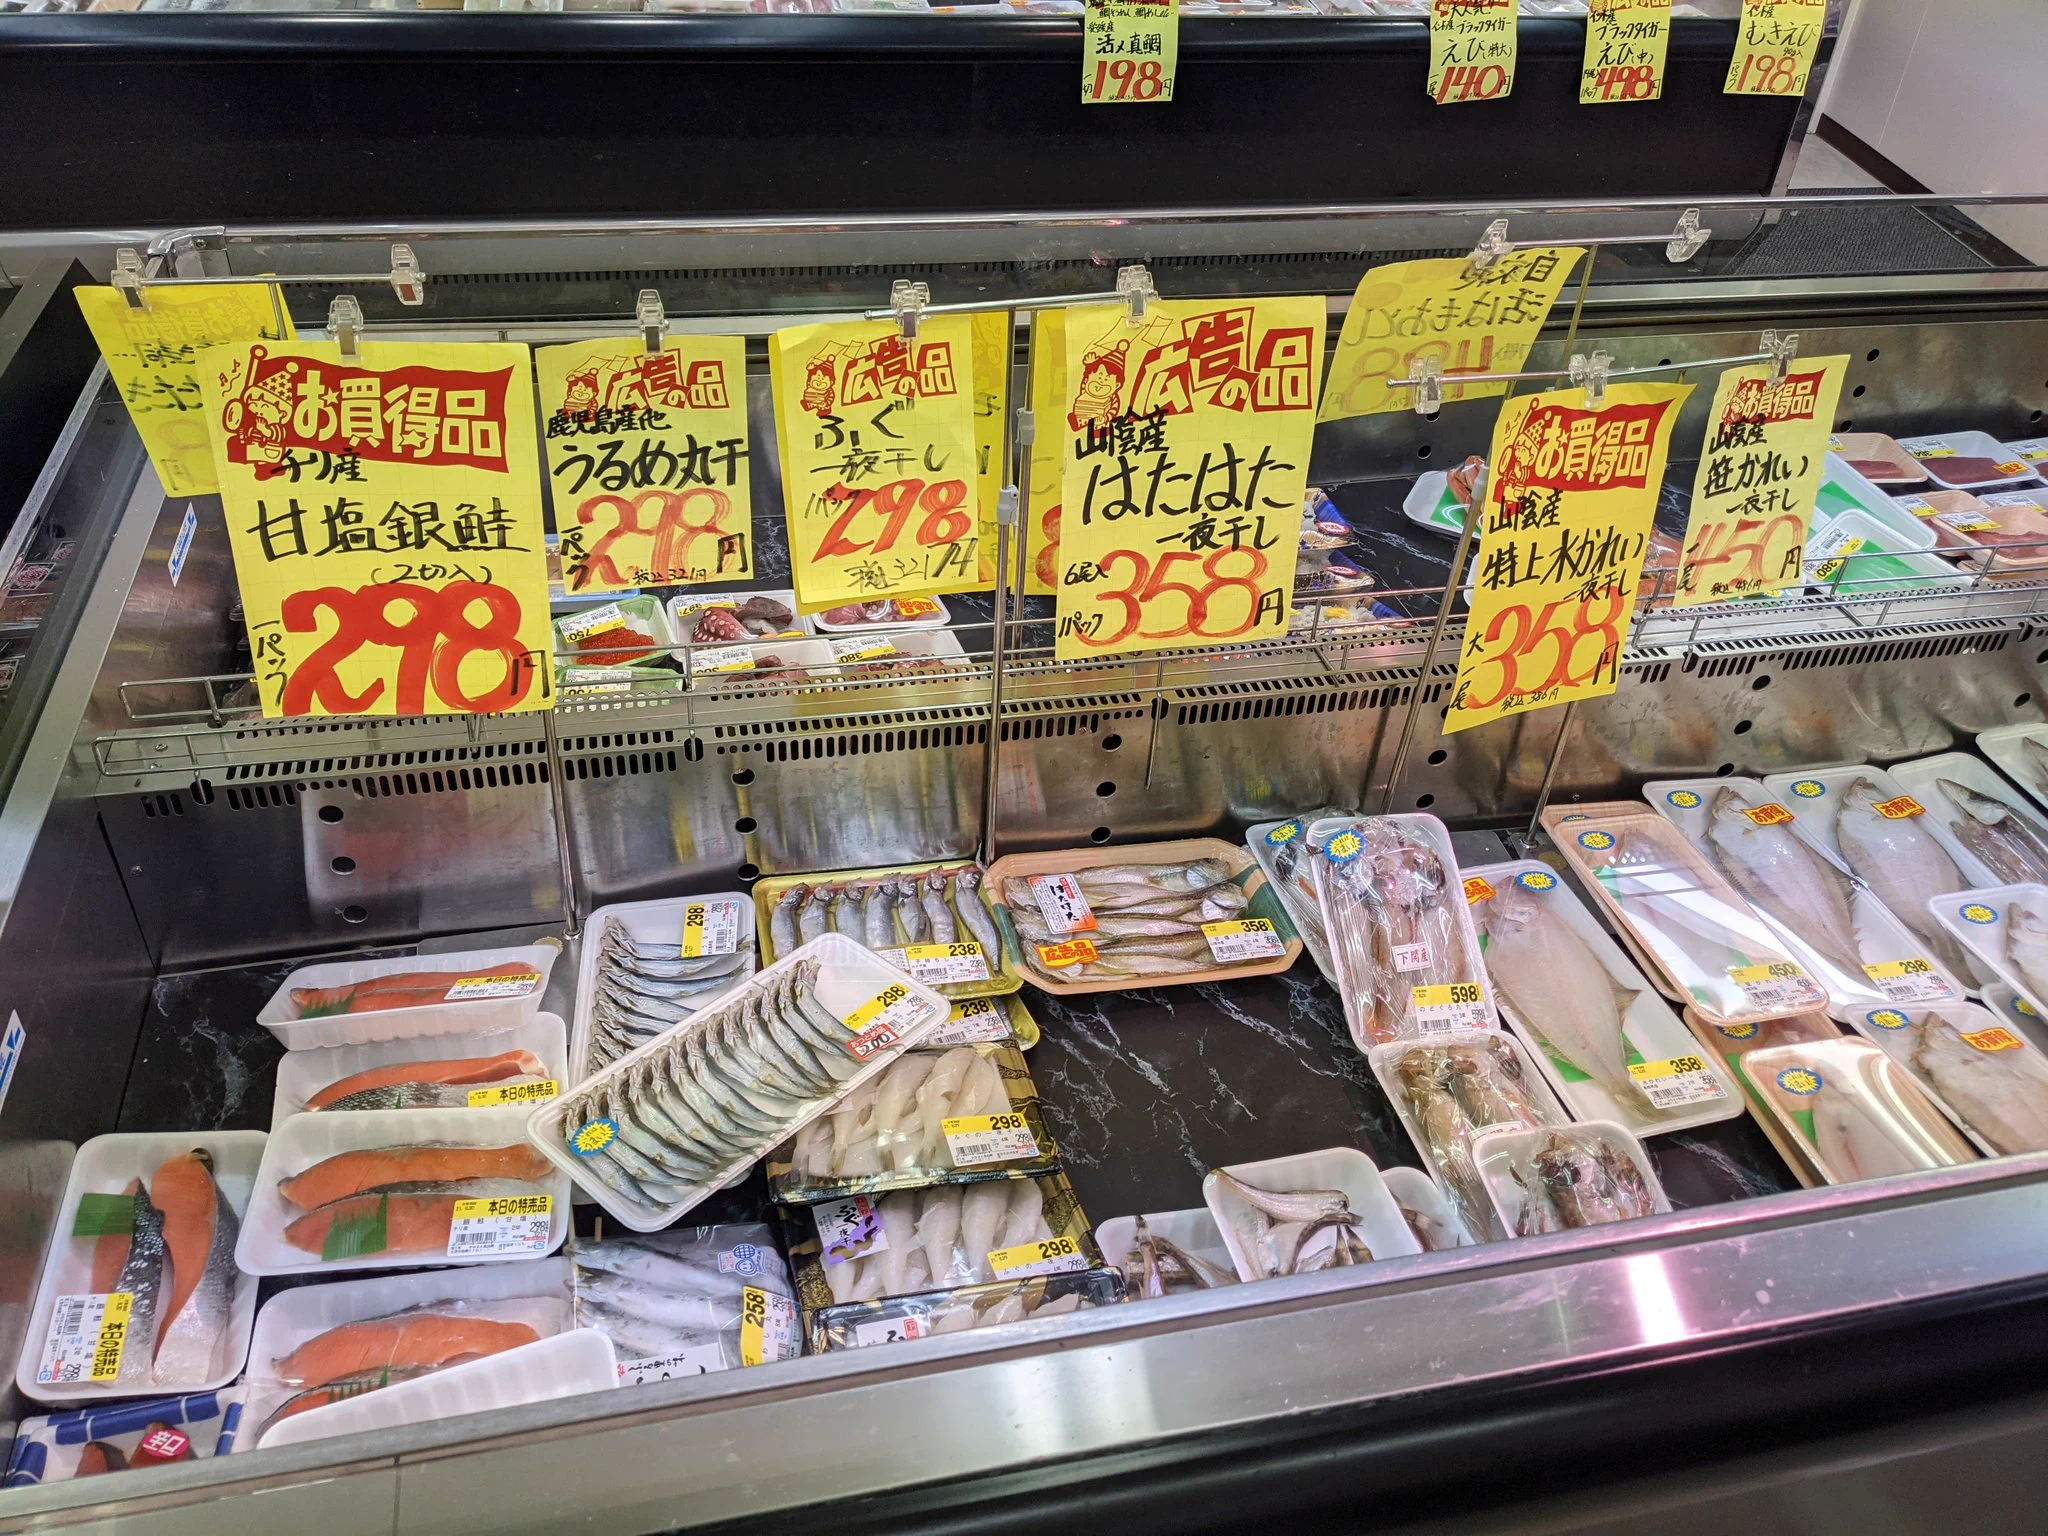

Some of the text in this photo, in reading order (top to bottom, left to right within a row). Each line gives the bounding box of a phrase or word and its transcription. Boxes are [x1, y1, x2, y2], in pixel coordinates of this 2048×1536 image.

[1595, 21, 1667, 40] ブラックタイガー
[1746, 20, 1820, 47] むきえび
[1092, 59, 1162, 99] 198
[1436, 64, 1506, 103] 140
[1595, 65, 1654, 100] 498
[1736, 54, 1806, 93] 198 円
[607, 353, 728, 412] 広告の品
[841, 335, 957, 406] 広告の品
[1128, 308, 1314, 421] 広告の品
[294, 370, 503, 458] お買得品
[1743, 380, 1814, 420] お買得品
[814, 398, 915, 450] ふぐ
[1075, 404, 1170, 460] 山陰産
[1708, 412, 1768, 455] 山陰産
[553, 434, 750, 495] うるめ丸干
[810, 444, 951, 483] 一夜干し
[1535, 415, 1651, 484] お買得品
[1082, 442, 1296, 526] はたはた
[1725, 488, 1800, 516] 一夜干し
[247, 497, 531, 562] 甘塩銀鮭
[811, 479, 972, 563] 298
[1488, 486, 1565, 534] 山陰産
[576, 487, 749, 587] 298 円
[1155, 512, 1281, 551] 一夜干し
[1684, 514, 1804, 597] 450 円
[1816, 559, 1838, 578] 380
[1075, 545, 1284, 647] 358 円
[1563, 569, 1632, 604] 一夜干し
[281, 580, 550, 716] 298 円
[568, 627, 593, 642] 750
[1467, 586, 1625, 711] 358 円
[839, 651, 864, 663] 380
[686, 907, 705, 927] 298
[1240, 920, 1269, 933] 358
[949, 943, 977, 957] 238
[1044, 942, 1094, 962] 広告の品
[1898, 959, 1929, 975] 298
[1768, 962, 1797, 978] 450
[877, 986, 906, 1008] 298
[960, 999, 990, 1018] 238
[1450, 985, 1478, 1004] 598
[1669, 1056, 1702, 1074] 358
[499, 1081, 554, 1102] 本日の特売品
[990, 1115, 1022, 1131] 298
[488, 1196, 548, 1216] 本日の特売品
[835, 1205, 861, 1227] ふぐ
[1038, 1238, 1073, 1260] 298
[745, 1291, 766, 1329] 258
[92, 1322, 125, 1377] 本日の特売品
